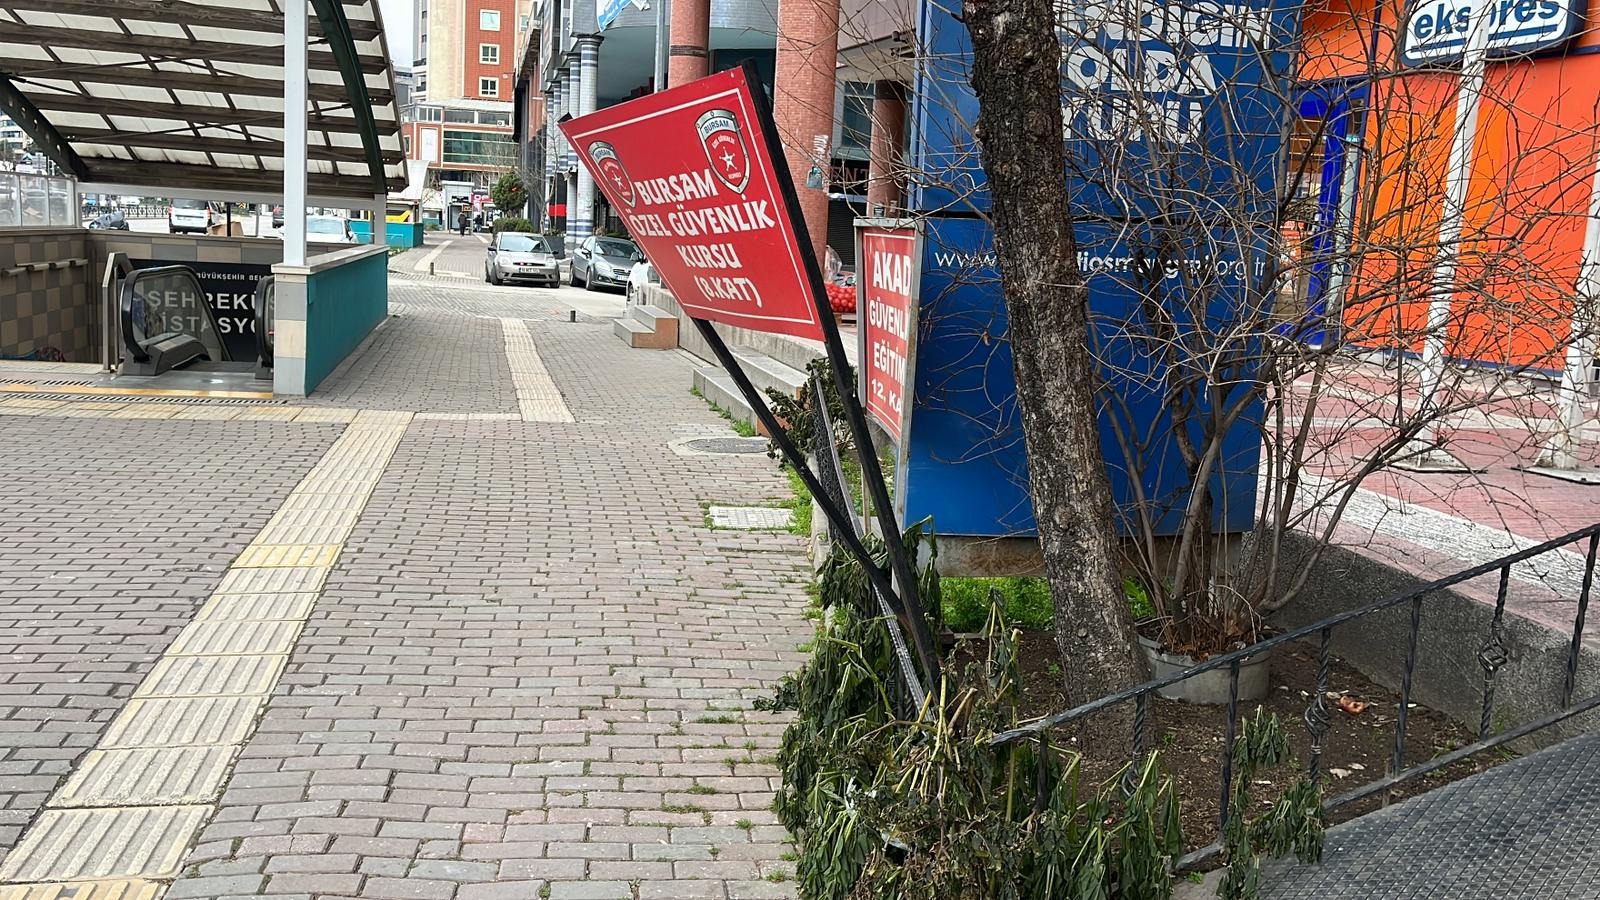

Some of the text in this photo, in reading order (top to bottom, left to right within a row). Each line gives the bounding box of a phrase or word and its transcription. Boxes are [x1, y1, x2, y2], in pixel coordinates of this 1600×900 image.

[1059, 45, 1217, 95] OLDA
[704, 120, 729, 134] BURSAM
[635, 168, 719, 206] BURSAM
[626, 193, 775, 237] ÖZEL GÜVENLİK
[675, 243, 742, 269] KURSU
[694, 275, 762, 308] (8.KAT)
